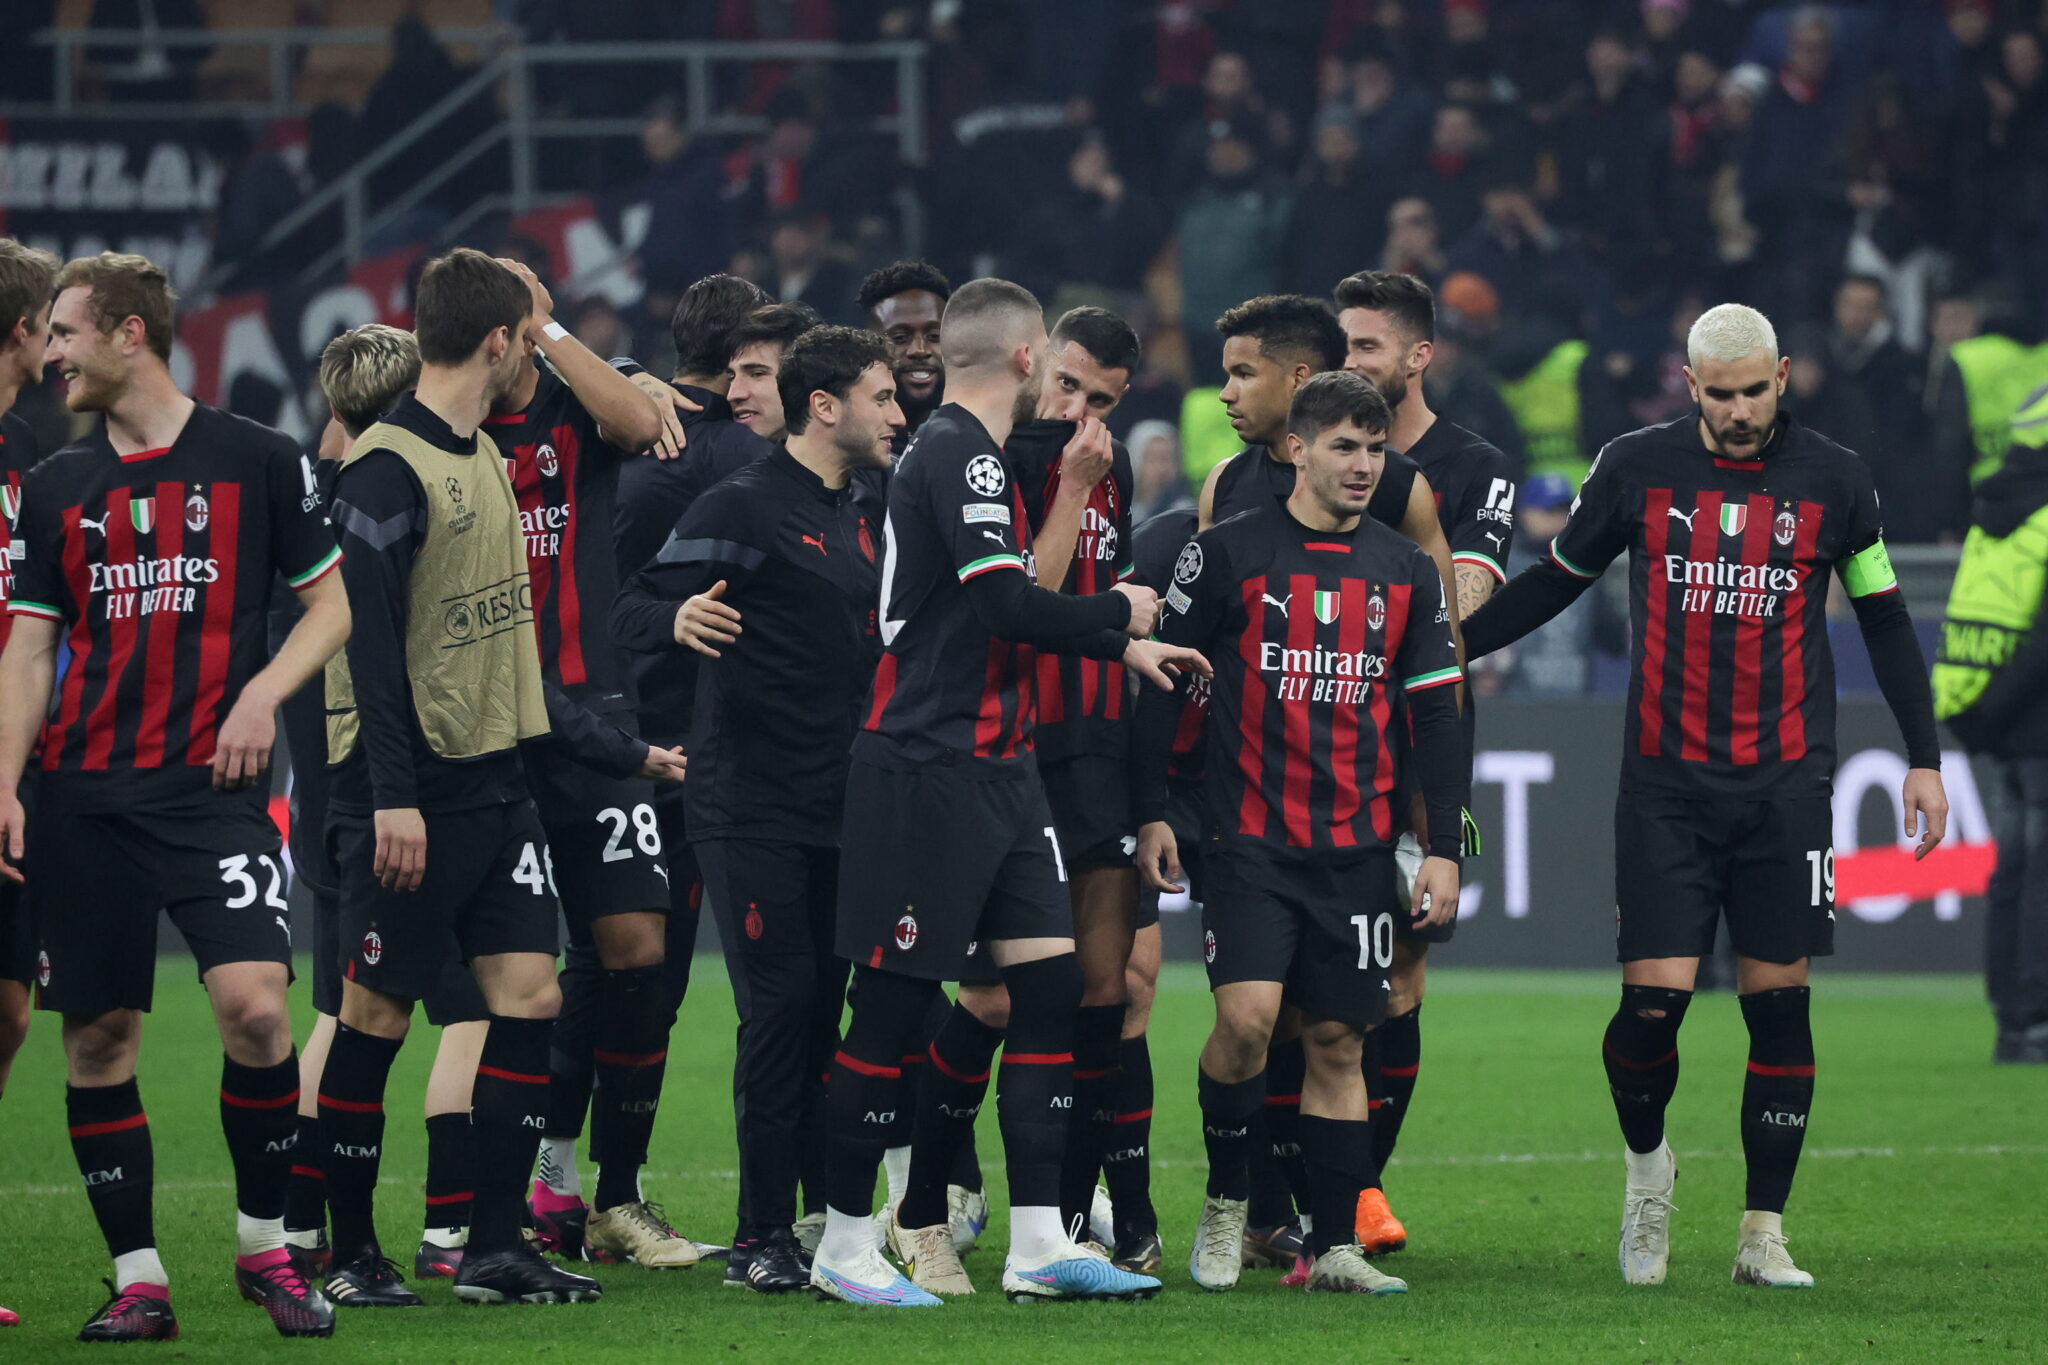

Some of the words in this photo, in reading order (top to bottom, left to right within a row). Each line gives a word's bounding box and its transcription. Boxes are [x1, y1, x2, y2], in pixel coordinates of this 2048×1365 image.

[88, 553, 219, 593] Emirates
[1664, 554, 1798, 592] Emirates
[106, 593, 136, 619] FLY
[140, 586, 196, 616] BETTER
[1681, 588, 1711, 613] FLY
[1714, 590, 1778, 617] BETTER
[1260, 642, 1388, 677] Emirates
[1277, 676, 1309, 701] FLY
[1311, 678, 1370, 704] BETTER
[595, 803, 661, 863] 28
[1044, 826, 1069, 882] 1
[219, 853, 289, 912] 32
[1806, 846, 1836, 907] 19
[1350, 911, 1393, 970] 10
[1762, 1110, 1806, 1128] ACM
[334, 1142, 377, 1158] ACM
